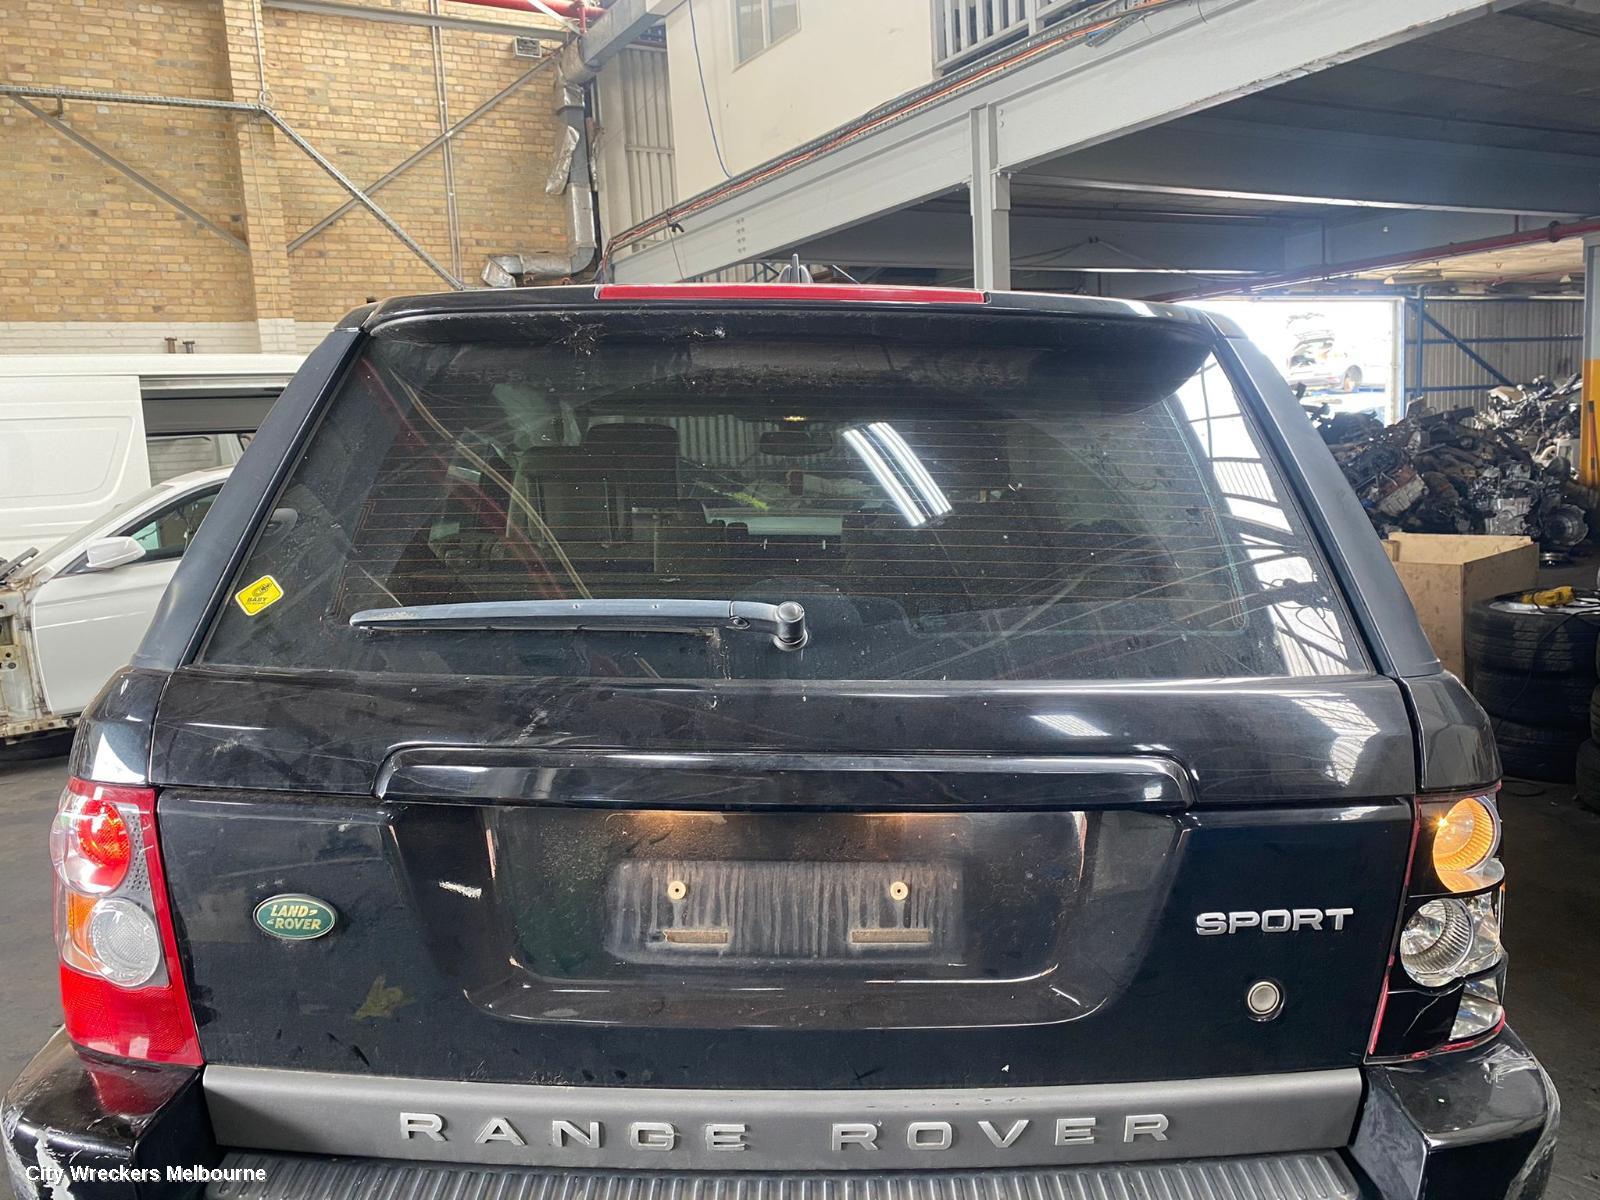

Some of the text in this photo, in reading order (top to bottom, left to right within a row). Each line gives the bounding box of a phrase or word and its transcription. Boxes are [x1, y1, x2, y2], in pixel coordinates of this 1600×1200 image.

[270, 904, 309, 917] LAND
[275, 918, 322, 930] ROVER
[1196, 908, 1354, 936] SPORT
[400, 1112, 1170, 1151] RANGE ROVER
